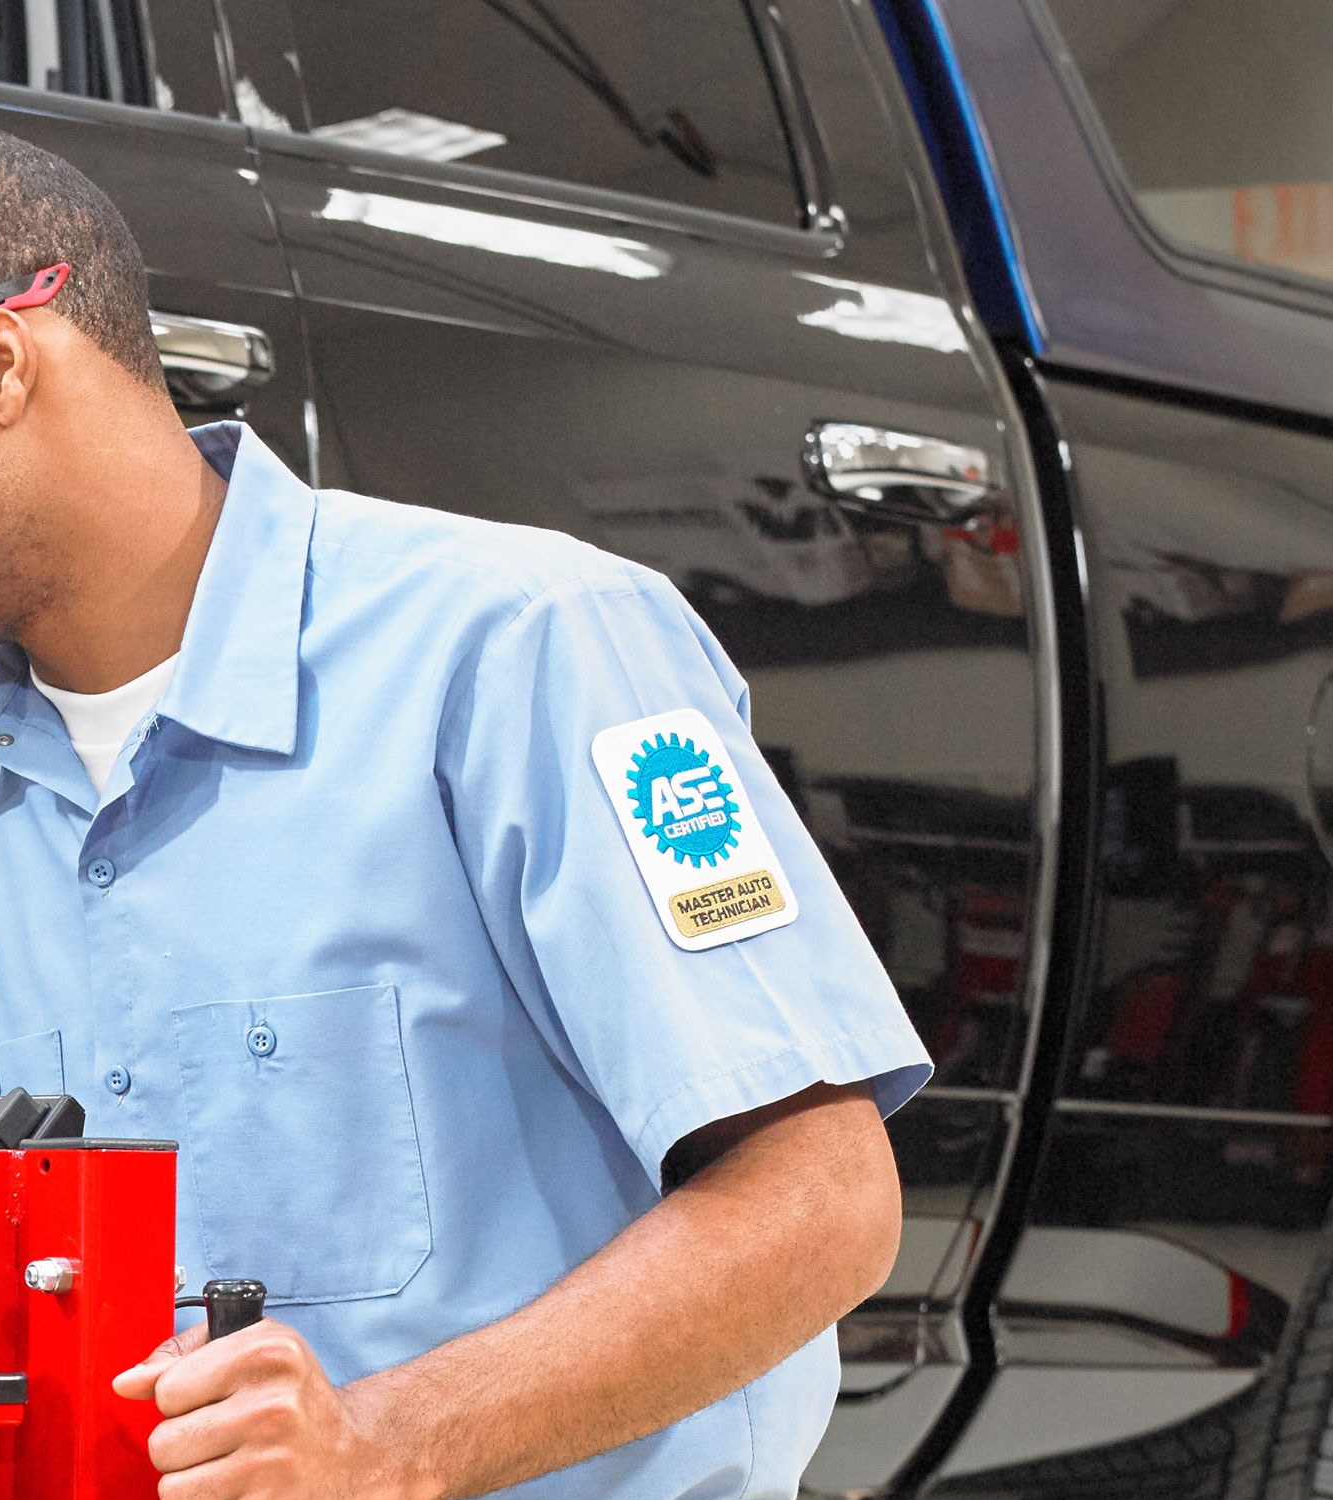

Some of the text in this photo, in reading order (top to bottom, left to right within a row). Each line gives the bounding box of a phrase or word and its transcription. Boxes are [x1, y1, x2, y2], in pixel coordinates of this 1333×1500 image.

[650, 766, 726, 827] ASE
[663, 809, 727, 840] CERTIFIED
[677, 876, 772, 914] MASTER AUTO
[690, 894, 771, 928] TECHNICIAN
